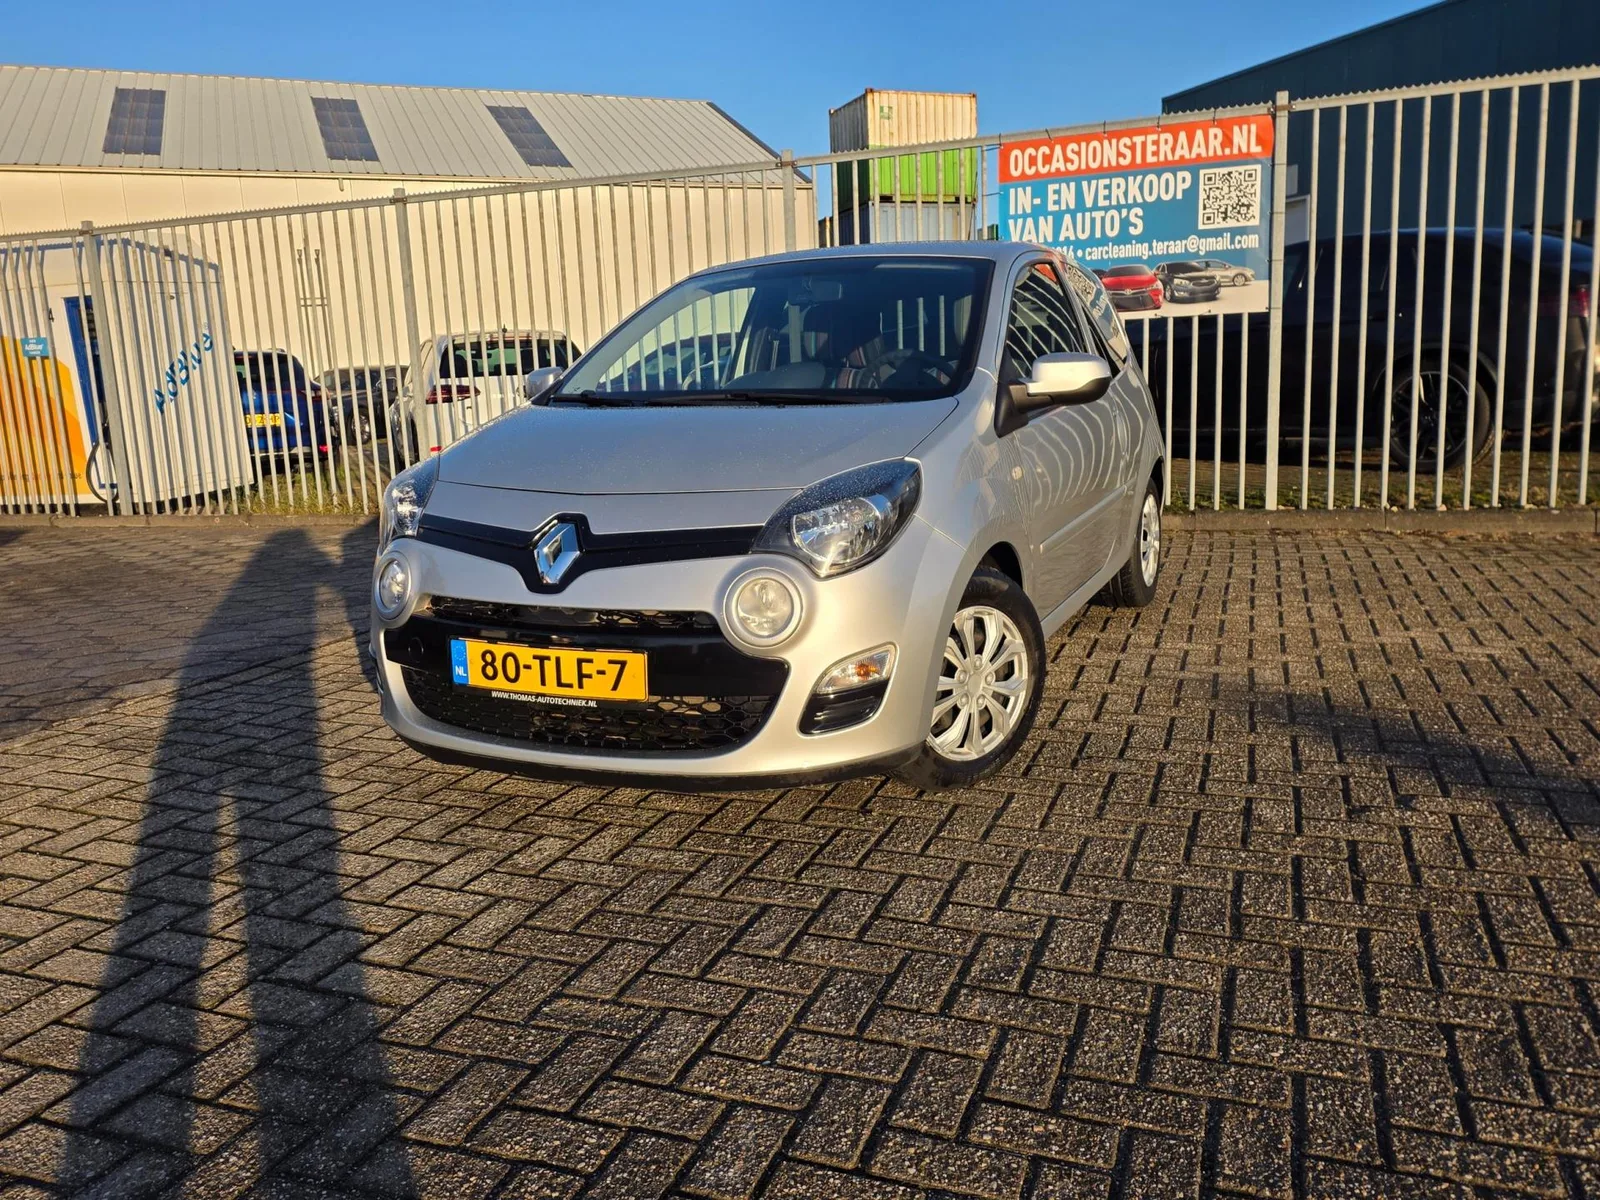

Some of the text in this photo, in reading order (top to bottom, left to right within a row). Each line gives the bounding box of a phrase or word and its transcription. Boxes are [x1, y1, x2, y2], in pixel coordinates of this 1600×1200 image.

[1009, 123, 1262, 177] OCCASIONSTERAAR.NL
[1009, 170, 1192, 215] IN- EN VERKOOP
[1008, 207, 1144, 243] VAN AUTO'S
[1085, 232, 1259, 261] carcleaning.teraar@gmail.com
[455, 665, 467, 677] NL
[480, 648, 628, 692] 80-TLF-7
[491, 690, 598, 708] WWW.THOMAS-AUTOTECHNIEK.NL
